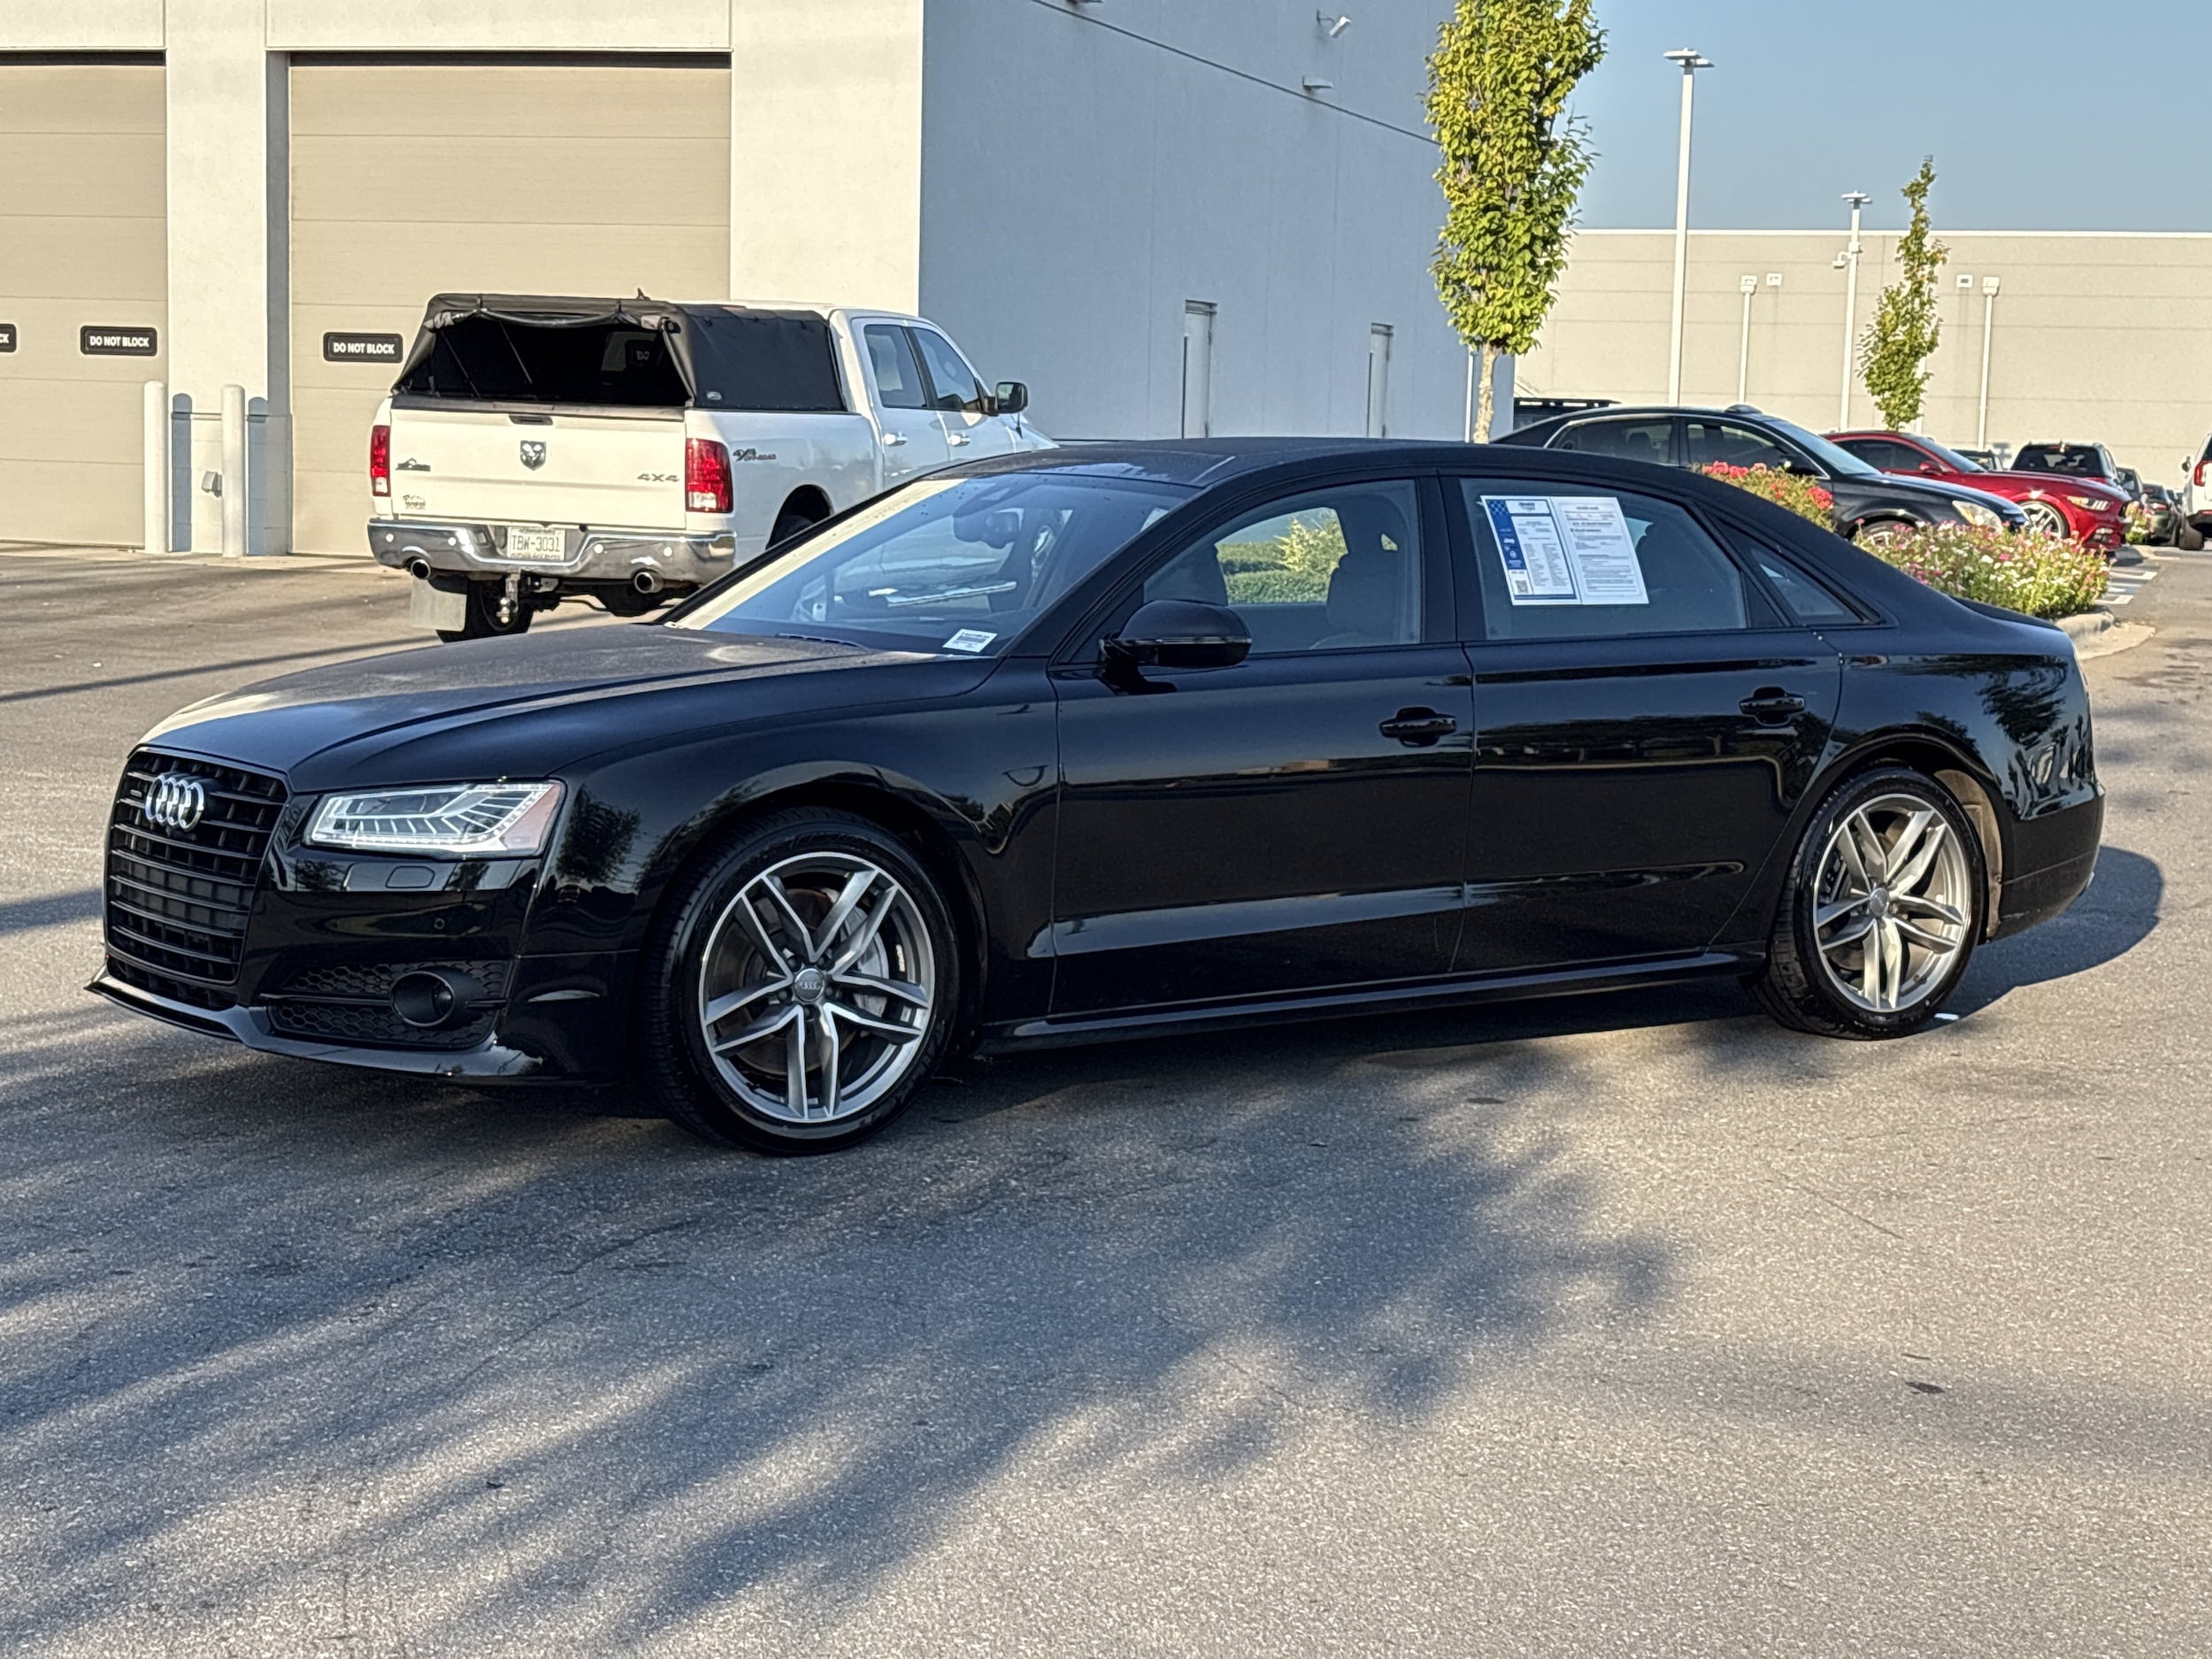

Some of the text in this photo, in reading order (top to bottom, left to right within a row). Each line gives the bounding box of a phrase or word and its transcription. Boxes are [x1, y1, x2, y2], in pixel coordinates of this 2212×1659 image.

[89, 335, 150, 348] DO NOT BLOCK
[333, 342, 396, 354] DO NOT BLOCK
[511, 535, 561, 552] TBW-3031
